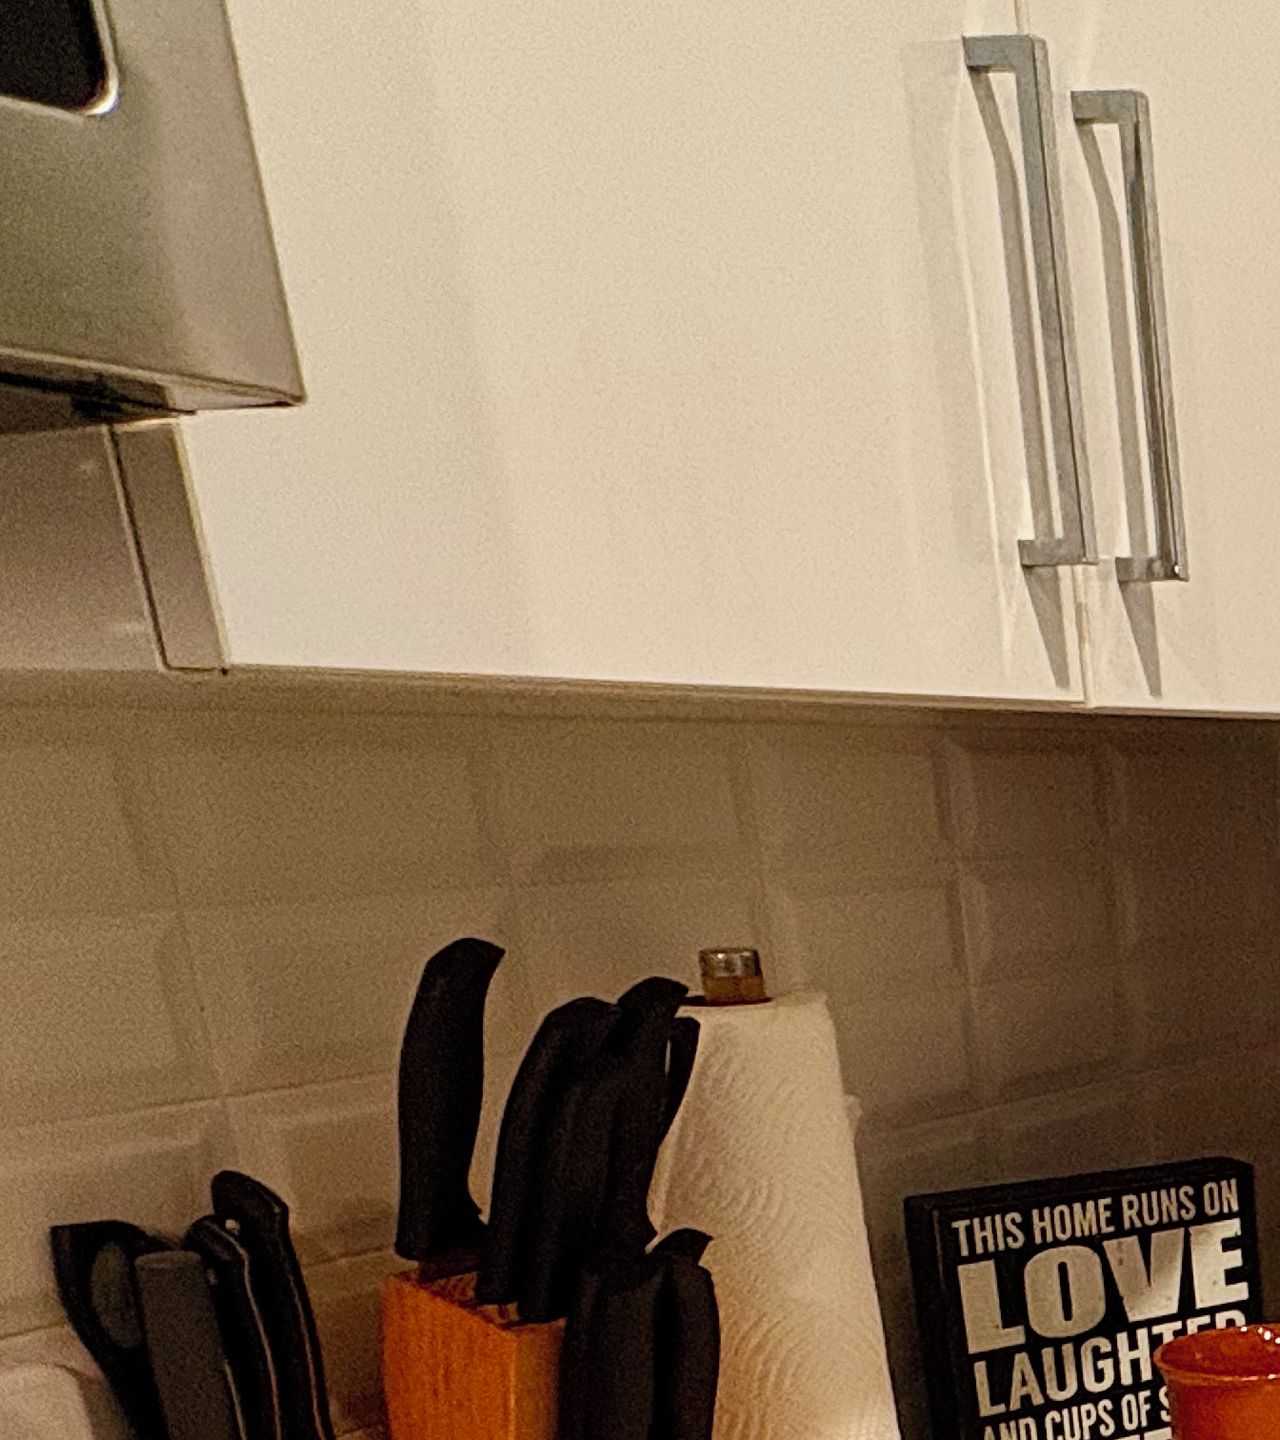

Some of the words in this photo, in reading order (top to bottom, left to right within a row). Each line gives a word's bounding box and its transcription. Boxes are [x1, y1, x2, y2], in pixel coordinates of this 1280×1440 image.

[952, 1211, 1025, 1257] THIS
[1032, 1197, 1115, 1244] HOME
[1121, 1185, 1196, 1230] RUNS
[1203, 1178, 1240, 1216] ON
[957, 1218, 1249, 1355] LOVE
[1121, 1390, 1152, 1432] OF
